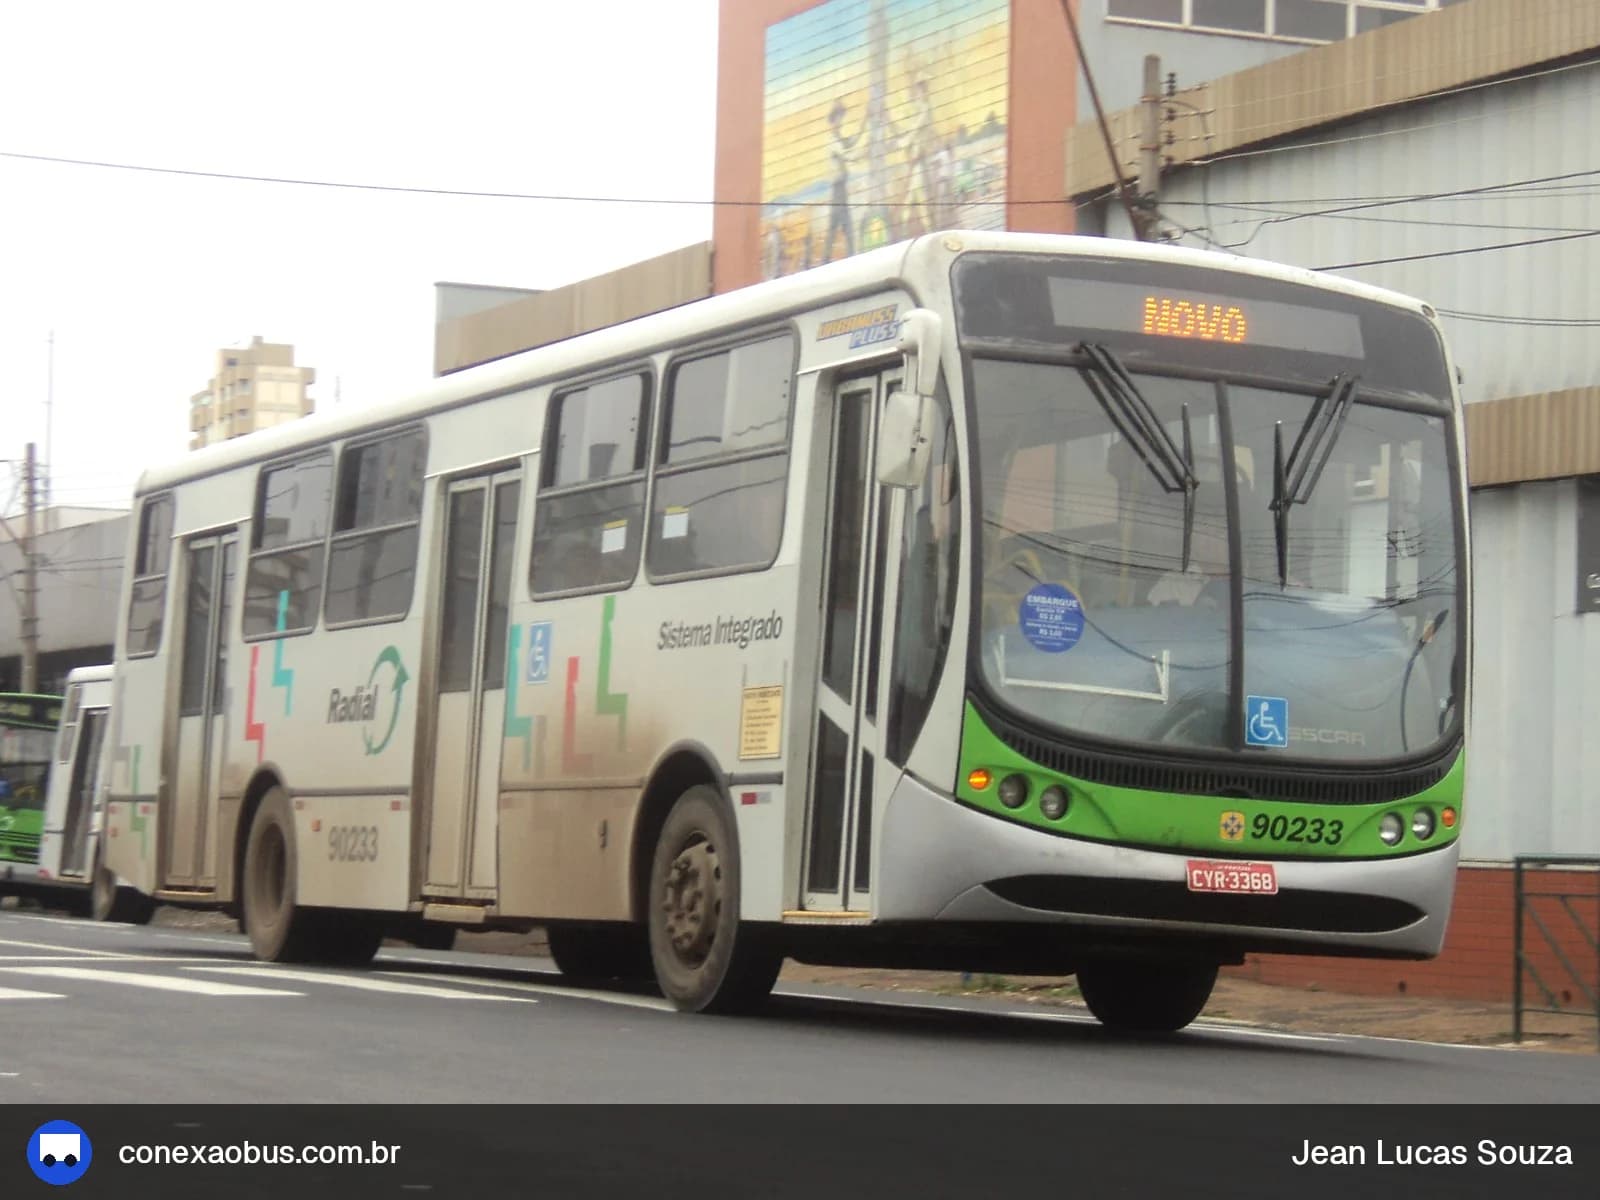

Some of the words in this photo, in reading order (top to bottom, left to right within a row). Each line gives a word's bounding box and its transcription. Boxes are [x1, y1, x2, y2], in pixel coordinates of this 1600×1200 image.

[1144, 297, 1246, 342] NOVO
[1026, 595, 1078, 608] EMBARQUE
[657, 620, 712, 650] Sistema
[713, 608, 783, 650] Integrado
[326, 684, 378, 723] Radial
[327, 825, 379, 862] 90233
[1251, 813, 1344, 845] 90233
